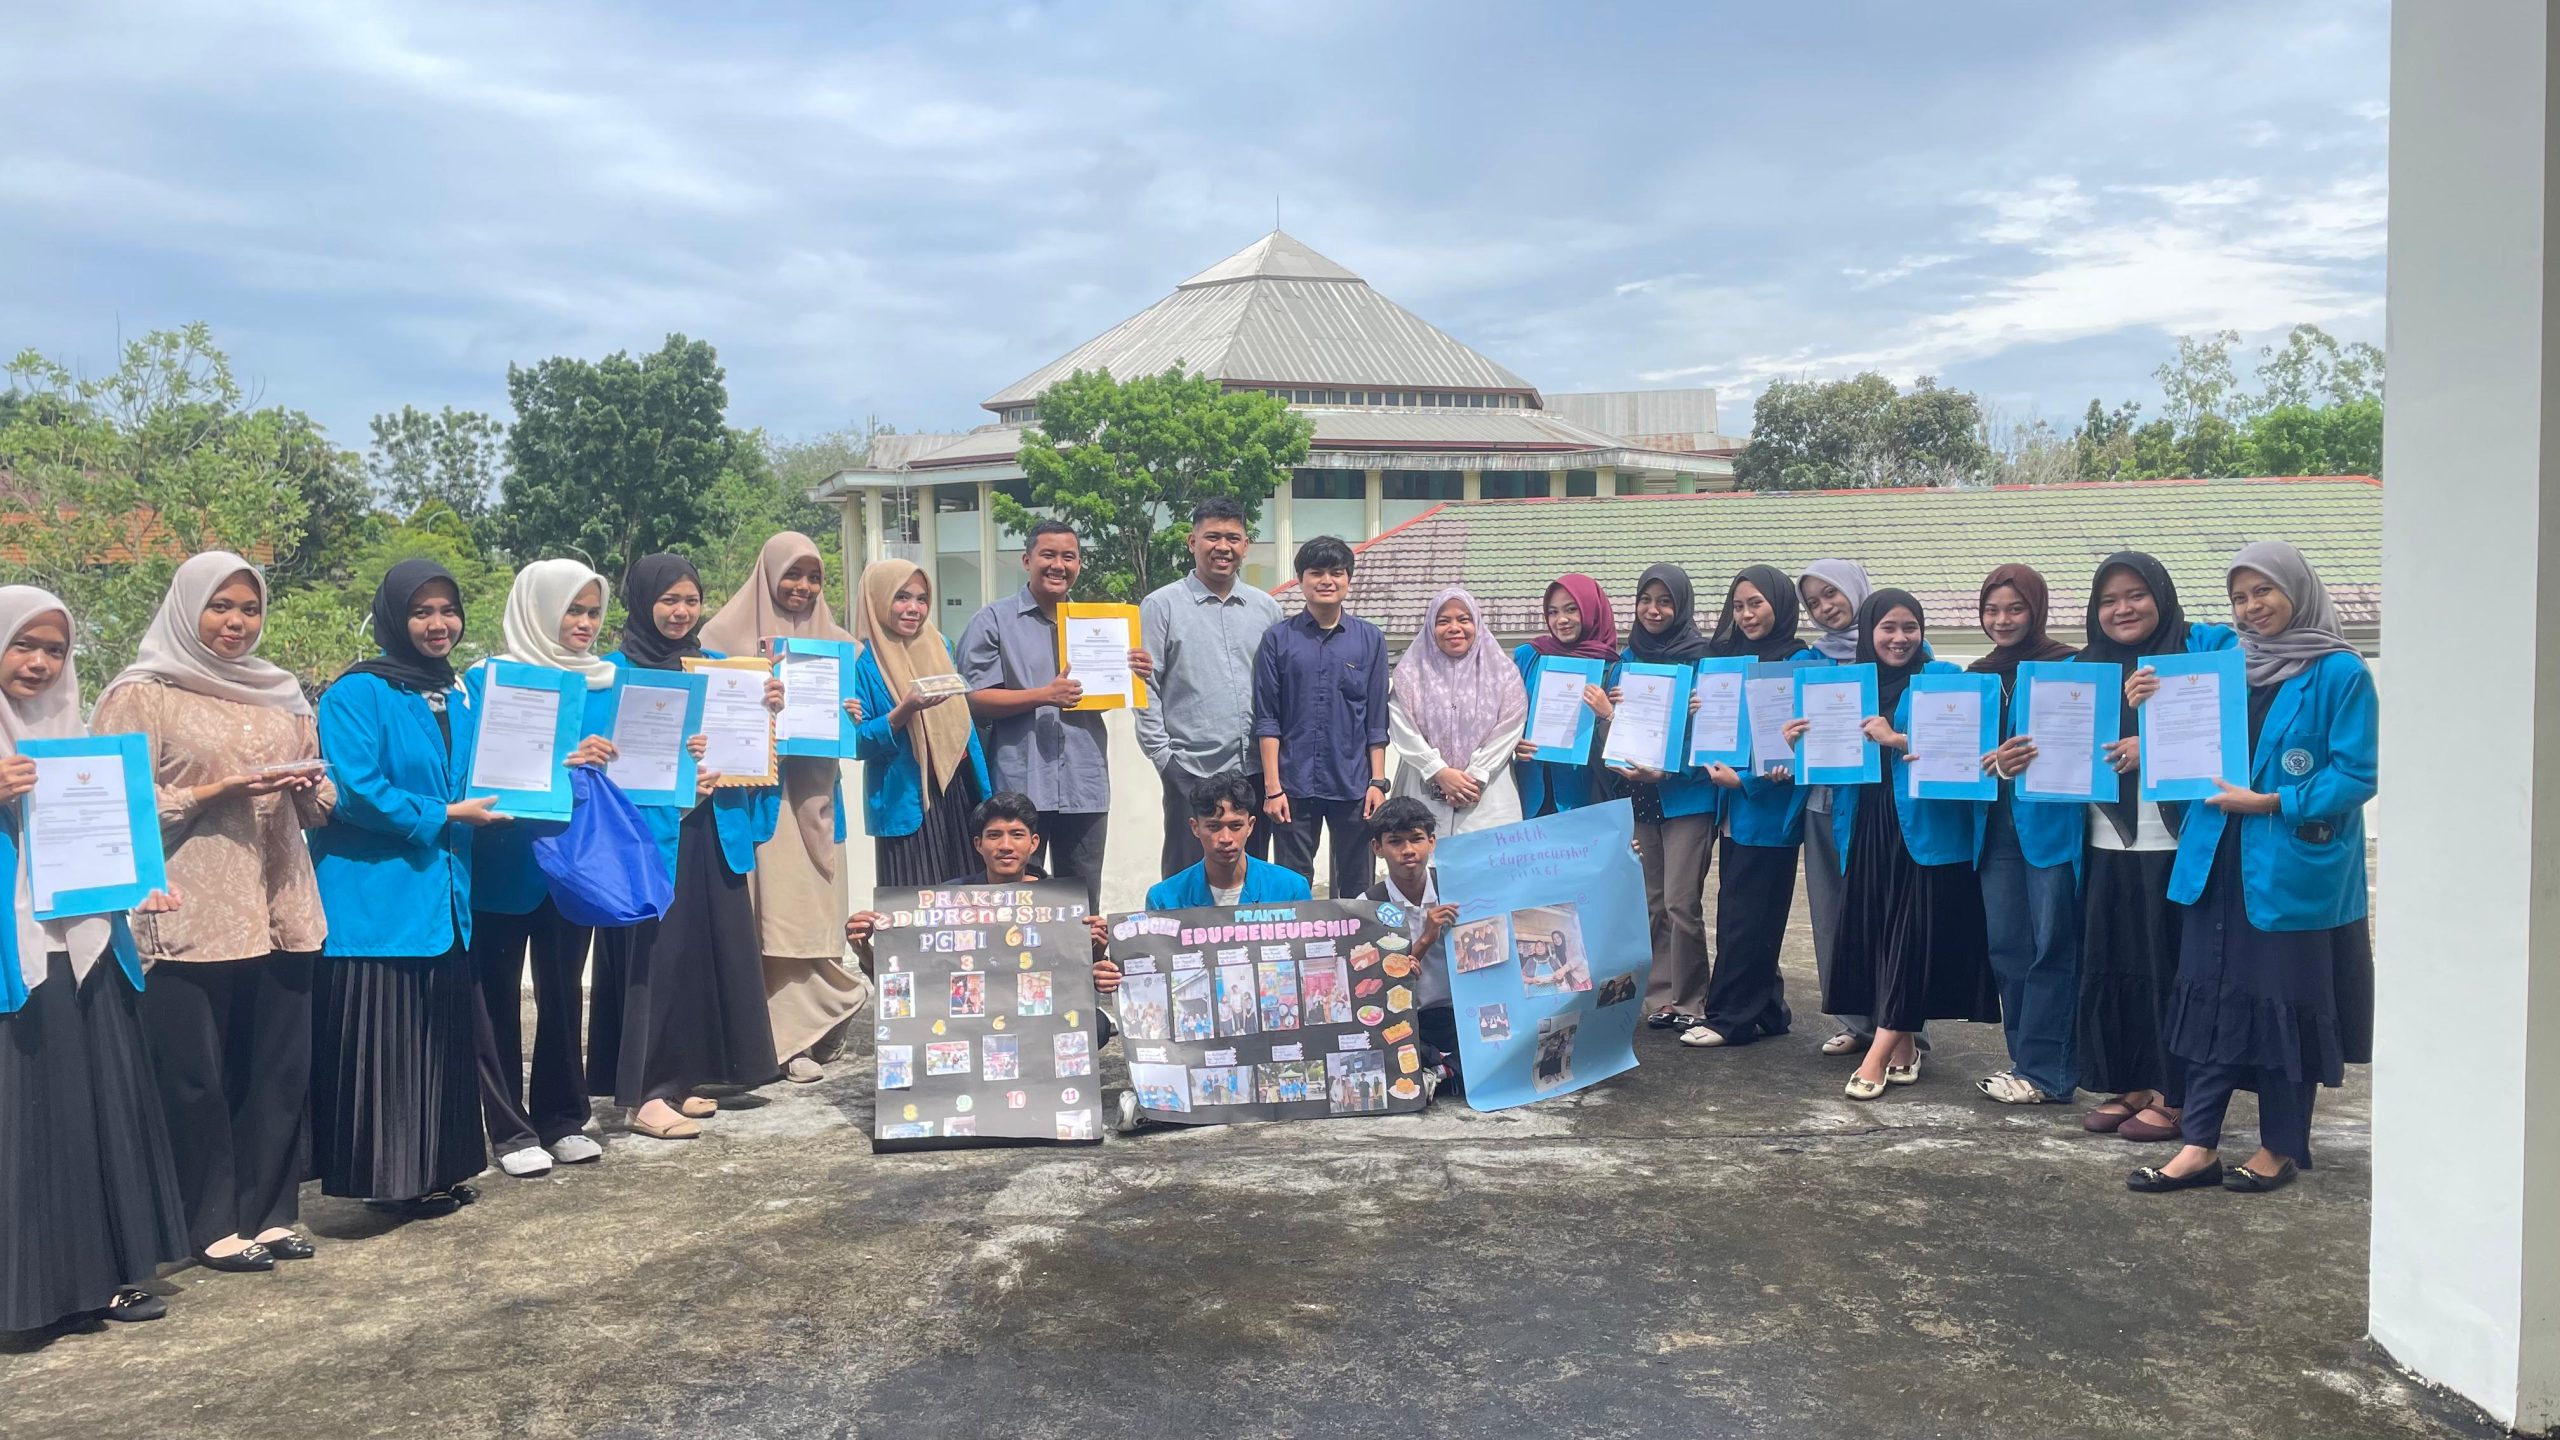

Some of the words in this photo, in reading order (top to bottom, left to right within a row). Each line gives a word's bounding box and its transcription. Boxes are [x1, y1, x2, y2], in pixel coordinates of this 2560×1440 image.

[1234, 908, 1296, 922] PRAKTIK
[1181, 919, 1361, 946] EDUPRENEURSHIP
[888, 955, 900, 972] 1
[961, 955, 974, 971] 3
[1019, 952, 1033, 970] 5
[932, 1019, 946, 1035] 4
[992, 1015, 1006, 1030] 6
[877, 1026, 891, 1040] 2
[1006, 1091, 1026, 1108] 10
